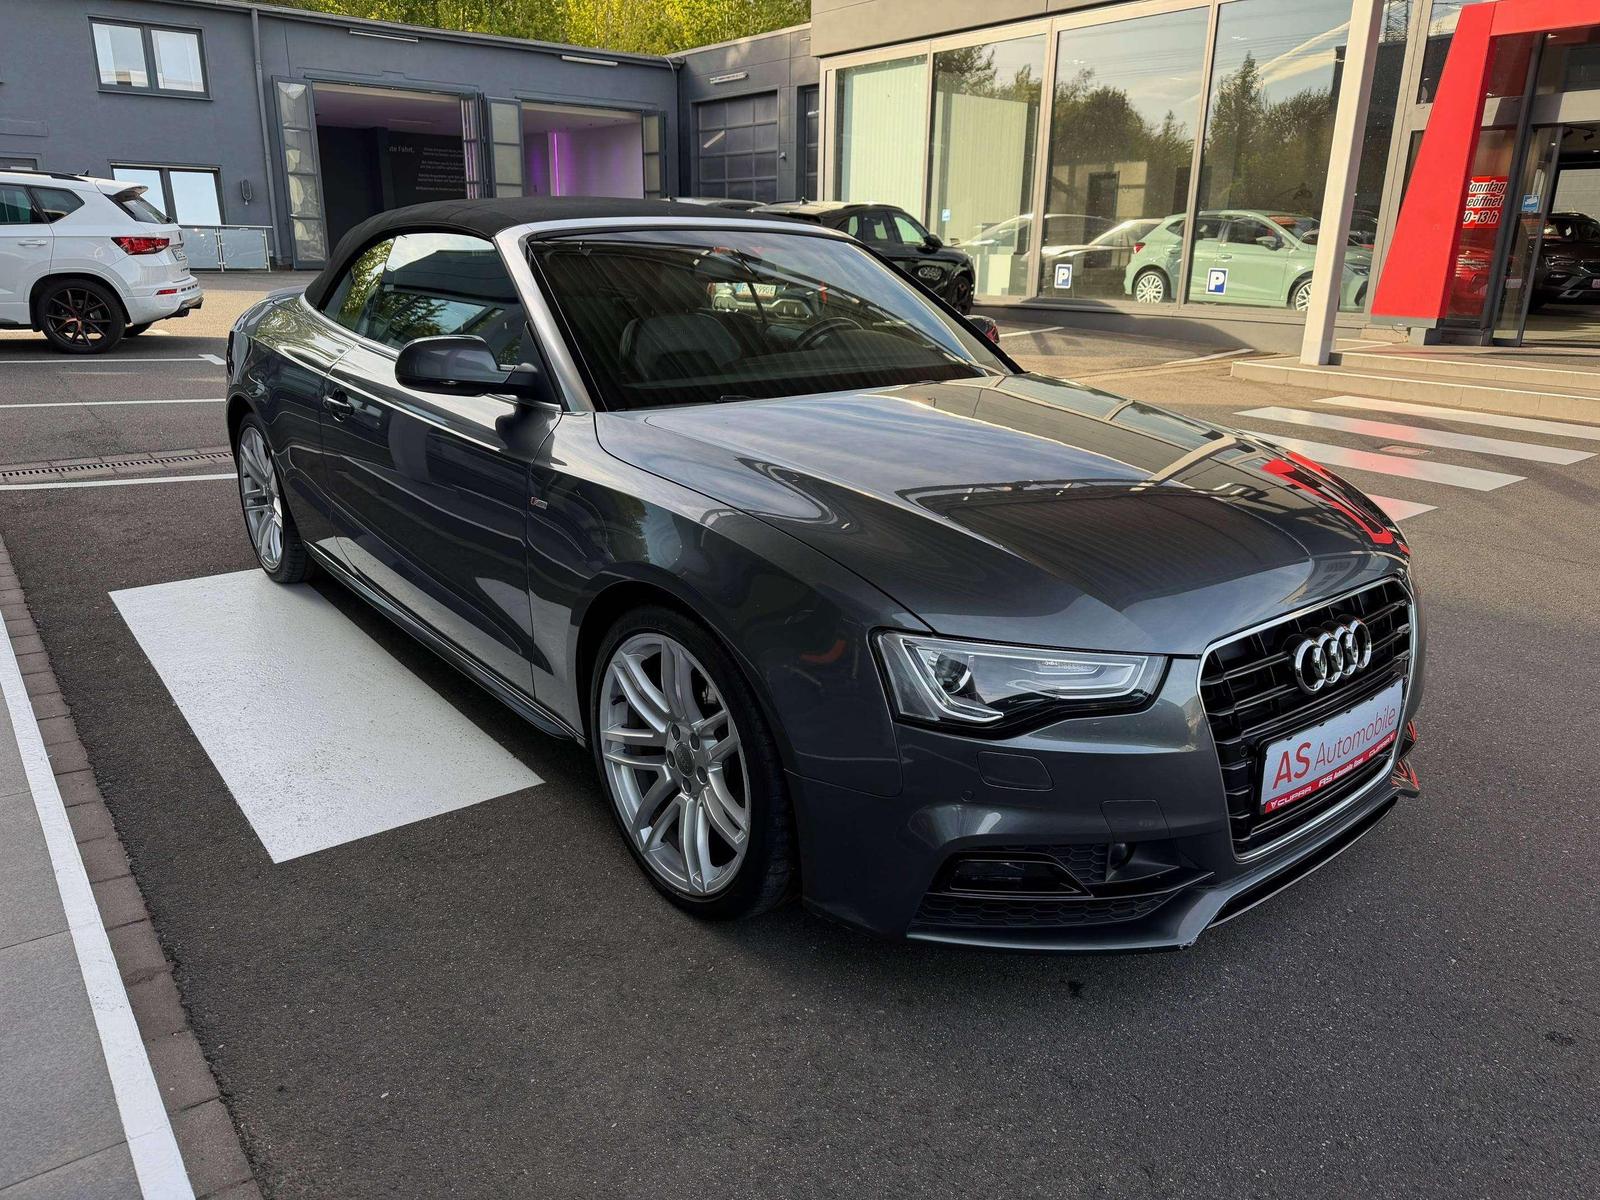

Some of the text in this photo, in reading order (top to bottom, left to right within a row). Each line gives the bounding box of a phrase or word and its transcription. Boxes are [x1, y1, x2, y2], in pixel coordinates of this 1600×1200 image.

[1469, 180, 1507, 194] onntag
[1466, 195, 1504, 208] eöffnet
[1463, 210, 1489, 223] 0-13
[1058, 269, 1069, 283] P
[1209, 271, 1225, 290] P
[1273, 705, 1396, 790] AS Automobile
